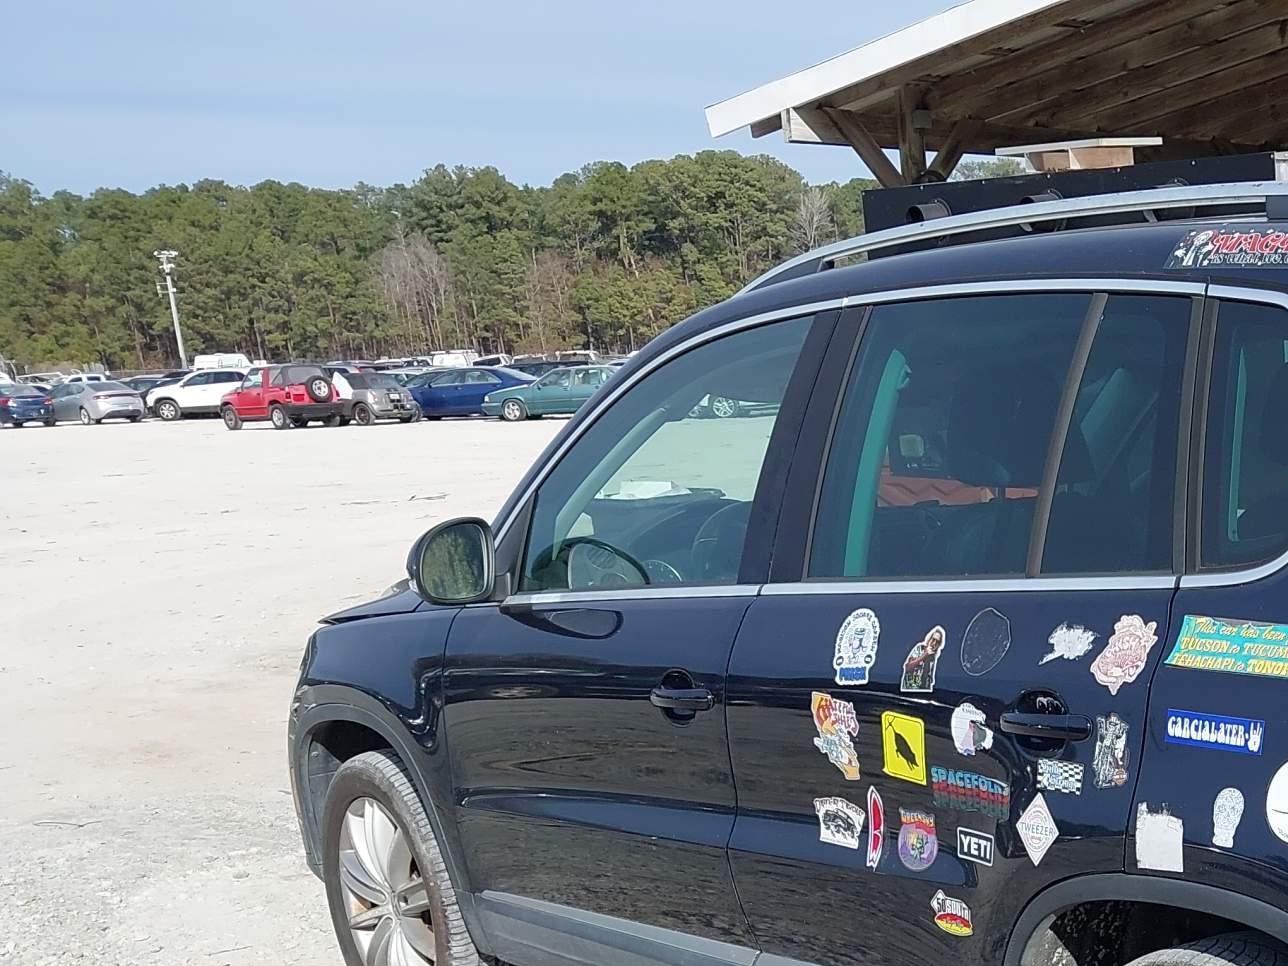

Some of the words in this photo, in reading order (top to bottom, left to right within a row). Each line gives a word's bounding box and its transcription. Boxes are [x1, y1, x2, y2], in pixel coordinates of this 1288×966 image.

[1195, 617, 1217, 634] This
[1220, 626, 1236, 637] car
[1242, 623, 1259, 638] has
[1263, 625, 1286, 642] been
[1181, 636, 1230, 653] TUCSON
[1172, 652, 1234, 671] TEHACHAPI
[1019, 822, 1054, 836] TWEEZER
[960, 833, 991, 860] YETI
